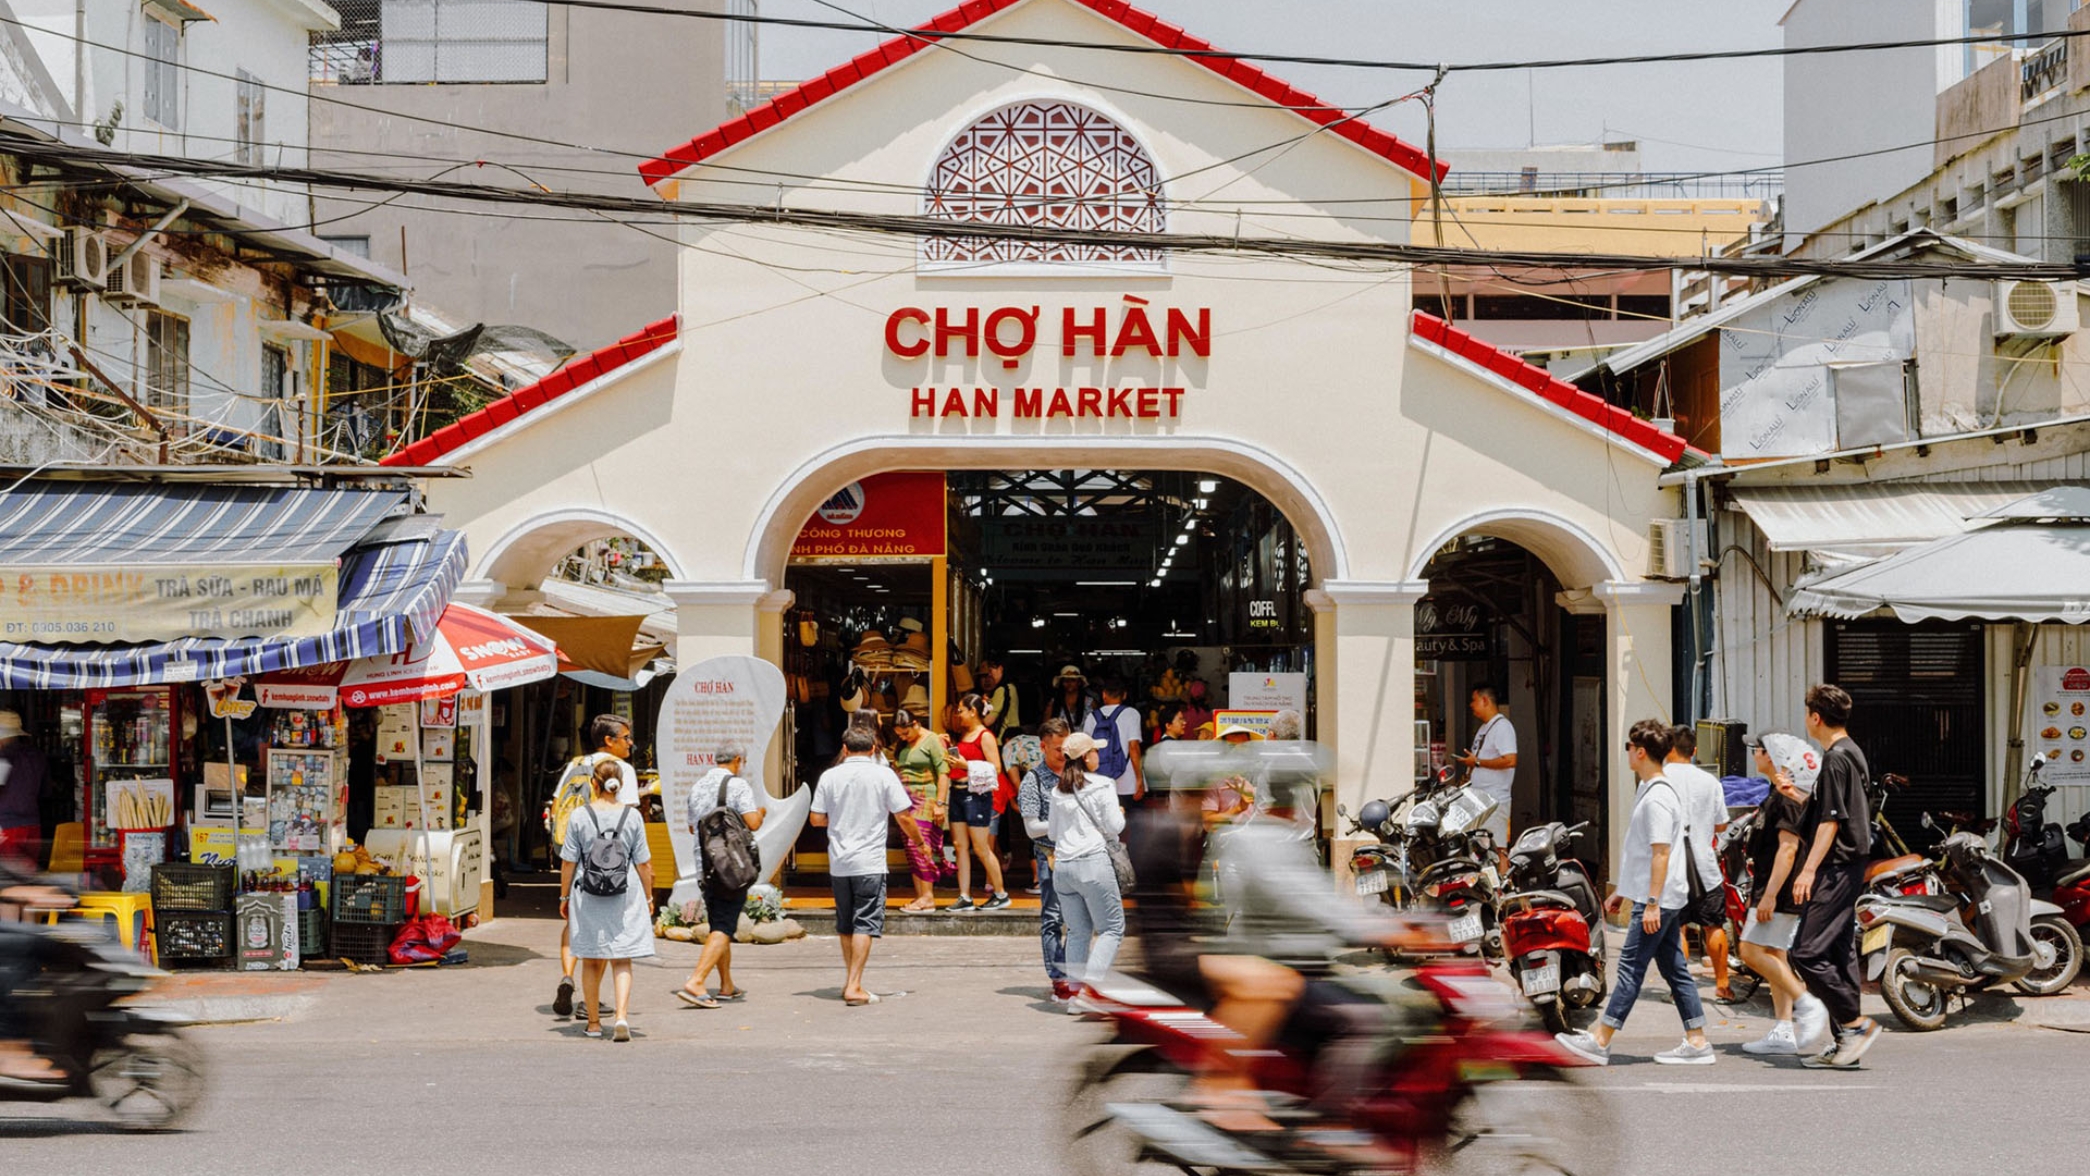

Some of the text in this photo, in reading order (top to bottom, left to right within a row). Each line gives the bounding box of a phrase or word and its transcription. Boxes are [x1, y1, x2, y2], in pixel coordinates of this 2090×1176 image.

[885, 293, 1211, 370] CHỢ HÀN
[911, 388, 1185, 418] HAN MARKET
[799, 526, 906, 539] CÔNG THƯƠNG
[815, 541, 845, 554] PHỐ
[848, 541, 869, 554] ĐÀ
[49, 572, 146, 608] DRINK
[155, 573, 190, 598] TRÀ
[197, 571, 234, 597] SỮA
[253, 578, 288, 597] RAU
[294, 573, 324, 597] MÁ
[189, 607, 293, 630] TRÀ CHANH
[1249, 619, 1269, 628] KEM
[6, 621, 115, 634] ĐT: 0905.036 210
[459, 637, 528, 662] SNOW
[1416, 638, 1486, 655] auty & Spa
[686, 753, 705, 766] HAN
[195, 833, 209, 844] 167
